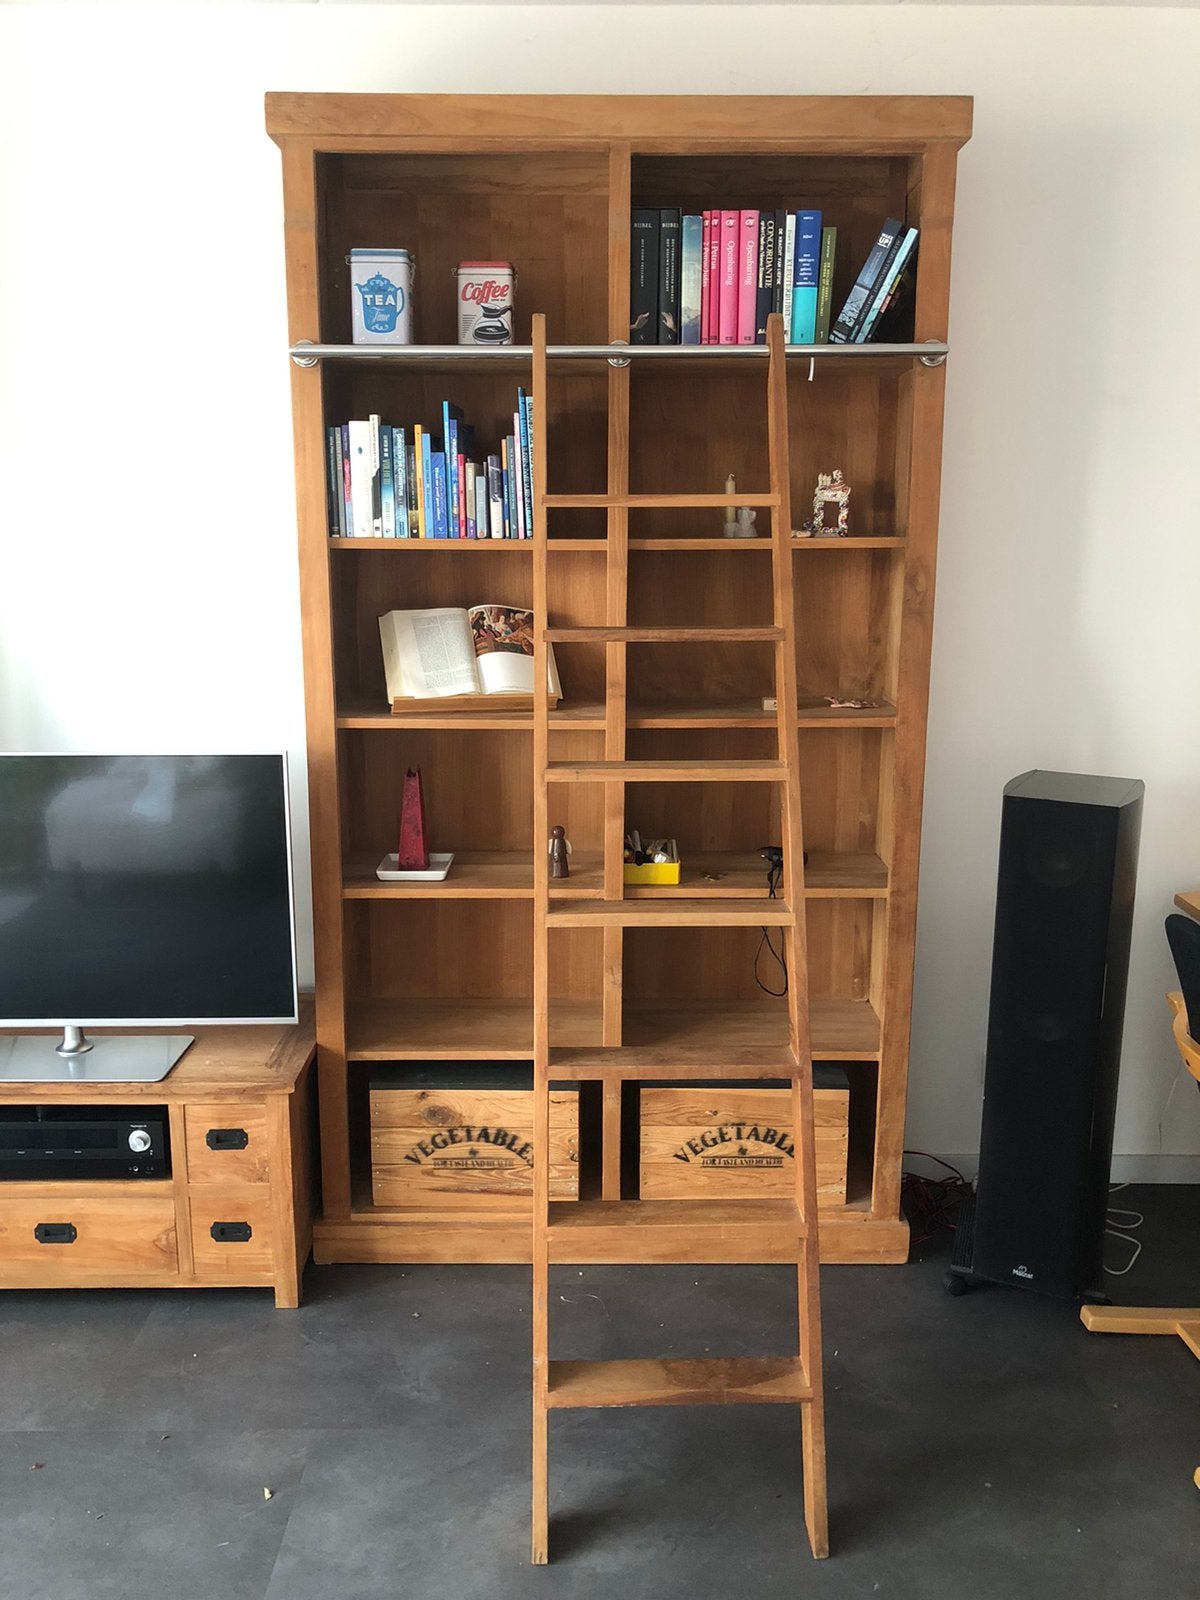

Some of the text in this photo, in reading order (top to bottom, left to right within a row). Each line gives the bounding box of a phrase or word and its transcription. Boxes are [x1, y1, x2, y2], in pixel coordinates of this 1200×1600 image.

[724, 240, 735, 286] Openbaring
[744, 240, 754, 286] Openbaring
[765, 220, 774, 288] CONCORDANTIE
[364, 295, 396, 306] TEA
[461, 280, 510, 305] Coffee
